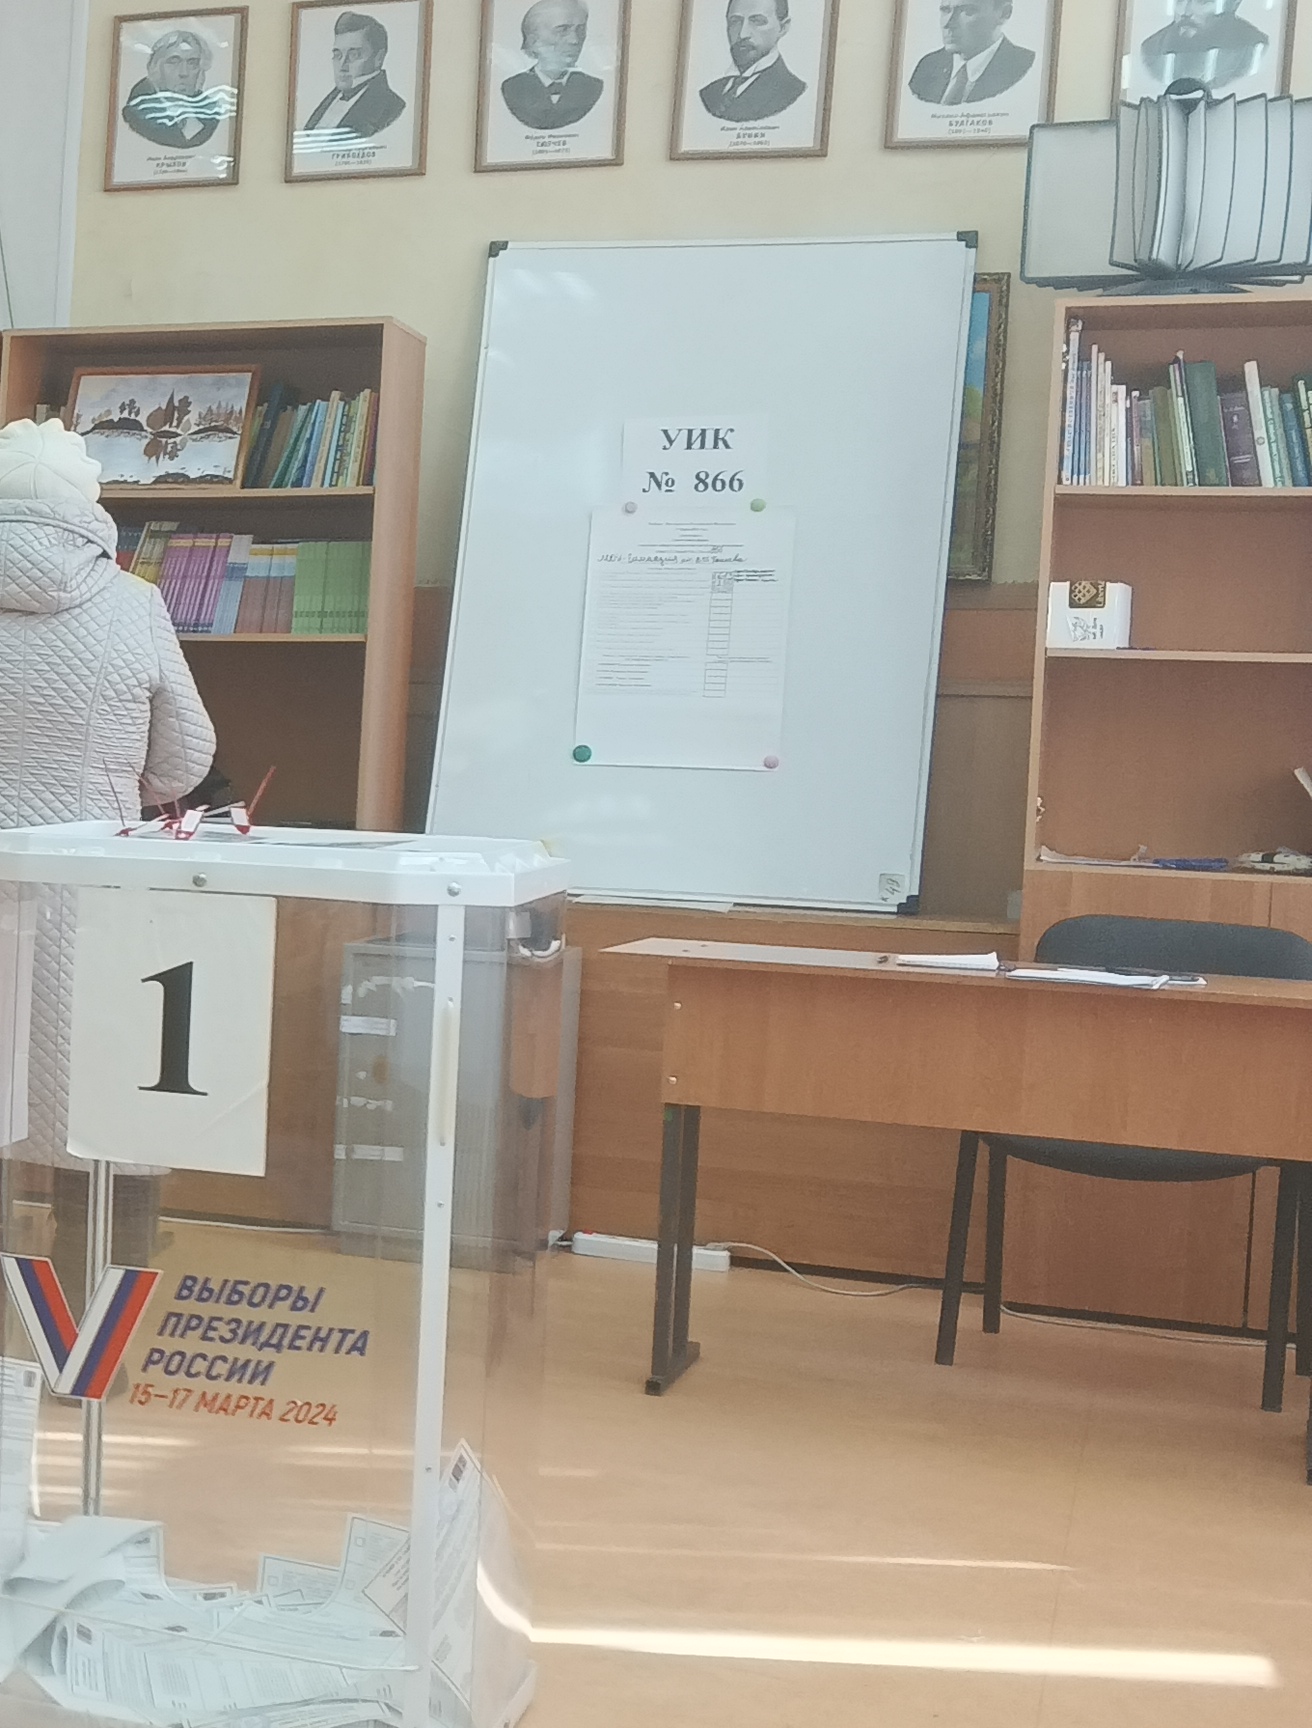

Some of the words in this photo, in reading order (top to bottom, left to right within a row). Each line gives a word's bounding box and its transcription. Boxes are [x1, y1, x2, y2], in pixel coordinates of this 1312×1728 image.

[660, 428, 735, 450] УИК
[641, 471, 675, 493] №
[693, 470, 745, 493] 866
[137, 961, 209, 1097] 1
[174, 1274, 326, 1314] ВЫБОРЫ
[156, 1311, 371, 1357] ПРЕЗИДЕНТА
[141, 1347, 276, 1386] РОССИИ
[193, 1390, 276, 1421] МАРТА
[278, 1400, 339, 1428] 2024
